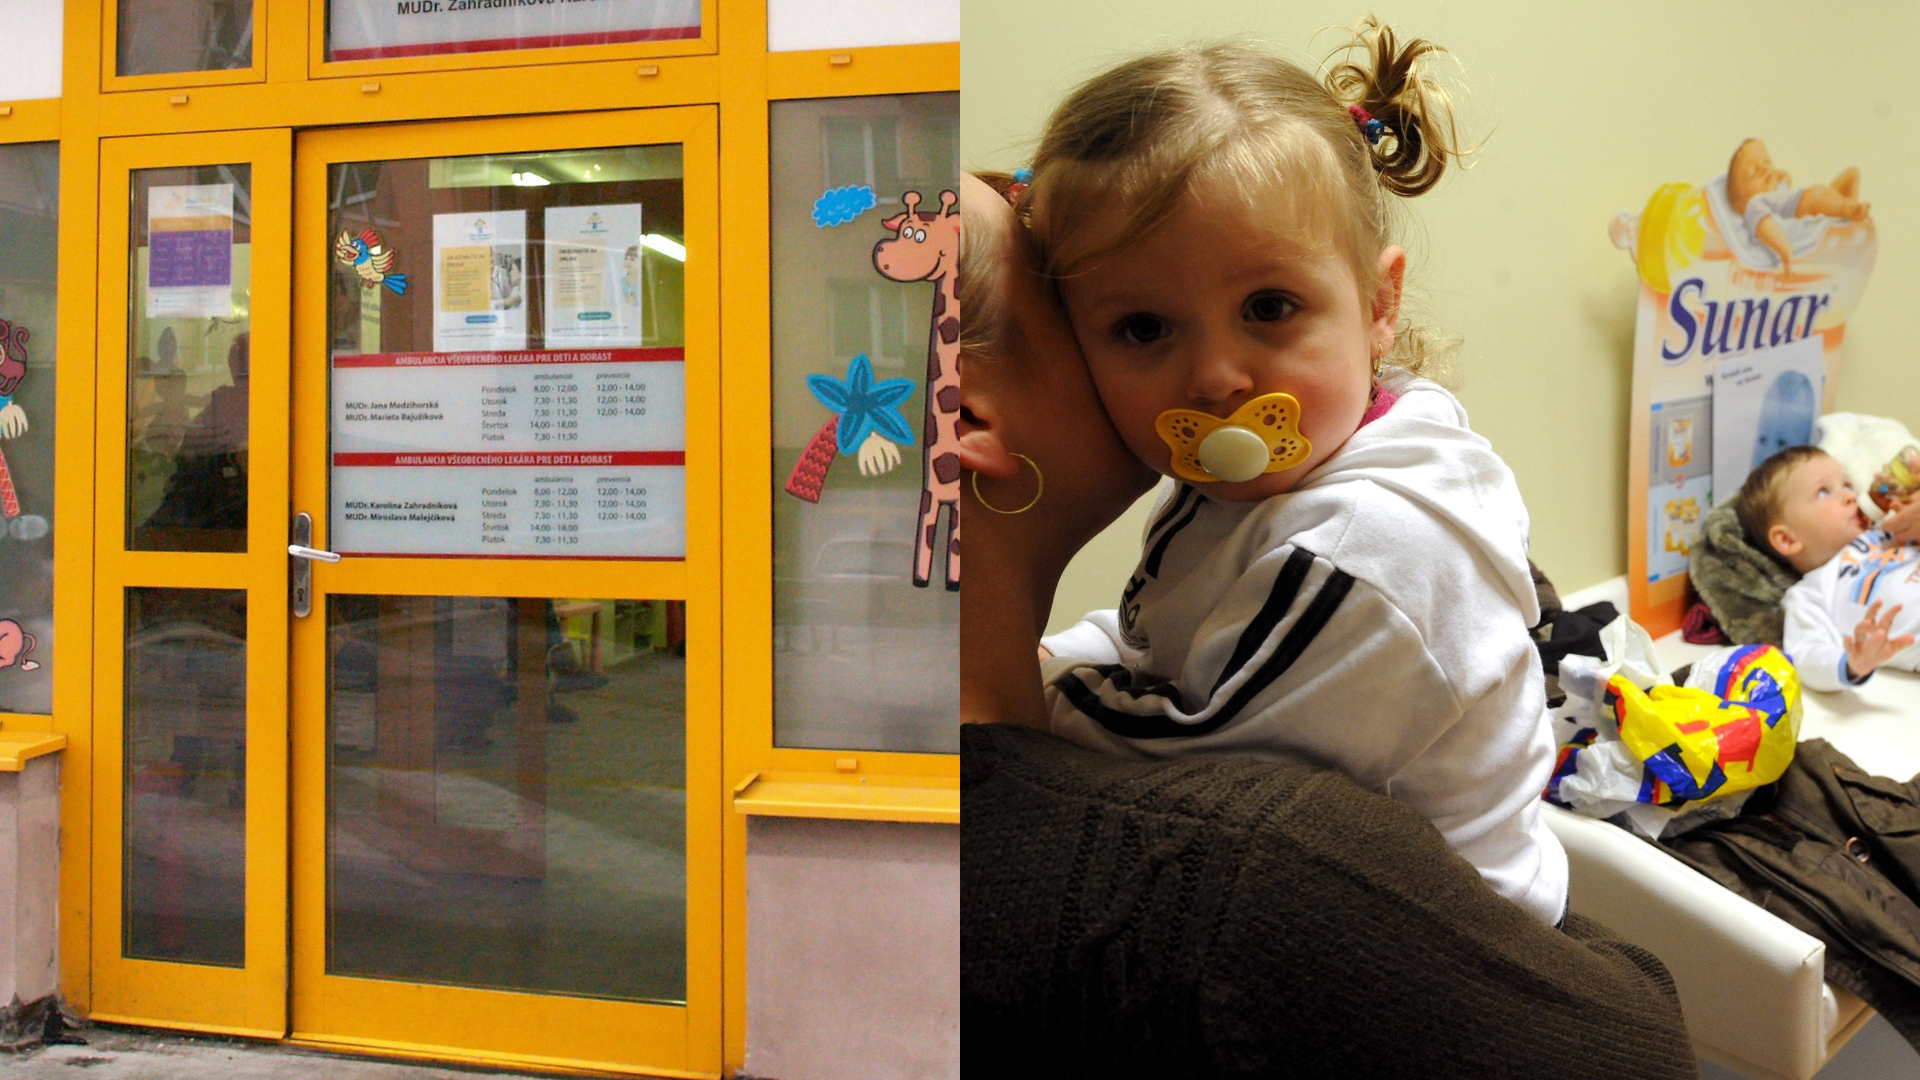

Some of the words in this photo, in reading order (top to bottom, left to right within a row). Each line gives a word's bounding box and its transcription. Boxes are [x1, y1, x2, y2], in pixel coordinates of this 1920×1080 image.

[397, 0, 443, 14] MUDr.
[1661, 277, 1830, 361] Sunar
[395, 357, 446, 365] AMBULANCIA
[504, 354, 534, 363] LEKÁRA
[553, 354, 571, 362] DETI
[573, 353, 578, 361] A
[580, 352, 611, 361] DORAST
[389, 401, 438, 409] Medzihorská
[482, 409, 506, 417] Streda
[482, 421, 509, 429] Štvrtok
[482, 433, 505, 441] Piatok
[447, 455, 503, 464] VŠEOBECNÉHO
[504, 455, 534, 464] LEKÁRA
[537, 456, 551, 464] PRE
[554, 456, 571, 464] DETI
[573, 456, 580, 464] A
[581, 456, 612, 464] DORAST
